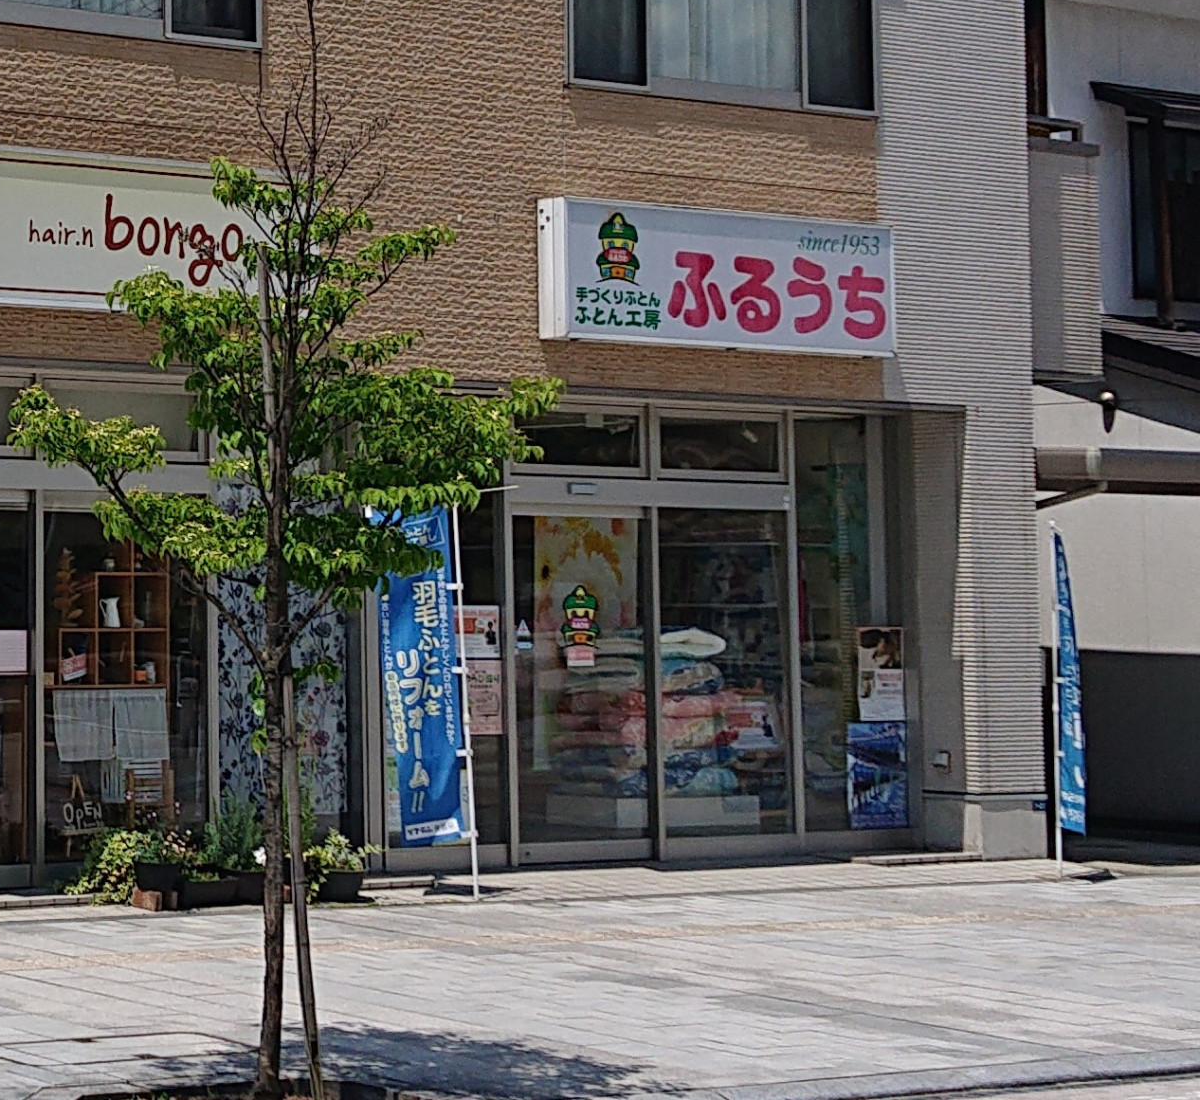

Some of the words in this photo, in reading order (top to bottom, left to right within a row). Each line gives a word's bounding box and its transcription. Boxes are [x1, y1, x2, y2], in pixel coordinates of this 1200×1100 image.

[104, 193, 244, 287] bongo
[574, 307, 662, 330] ふとん工房
[575, 286, 661, 308] 手づくりふとん
[667, 250, 887, 340] ふるうち
[412, 580, 443, 716] 羽毛ふとんを
